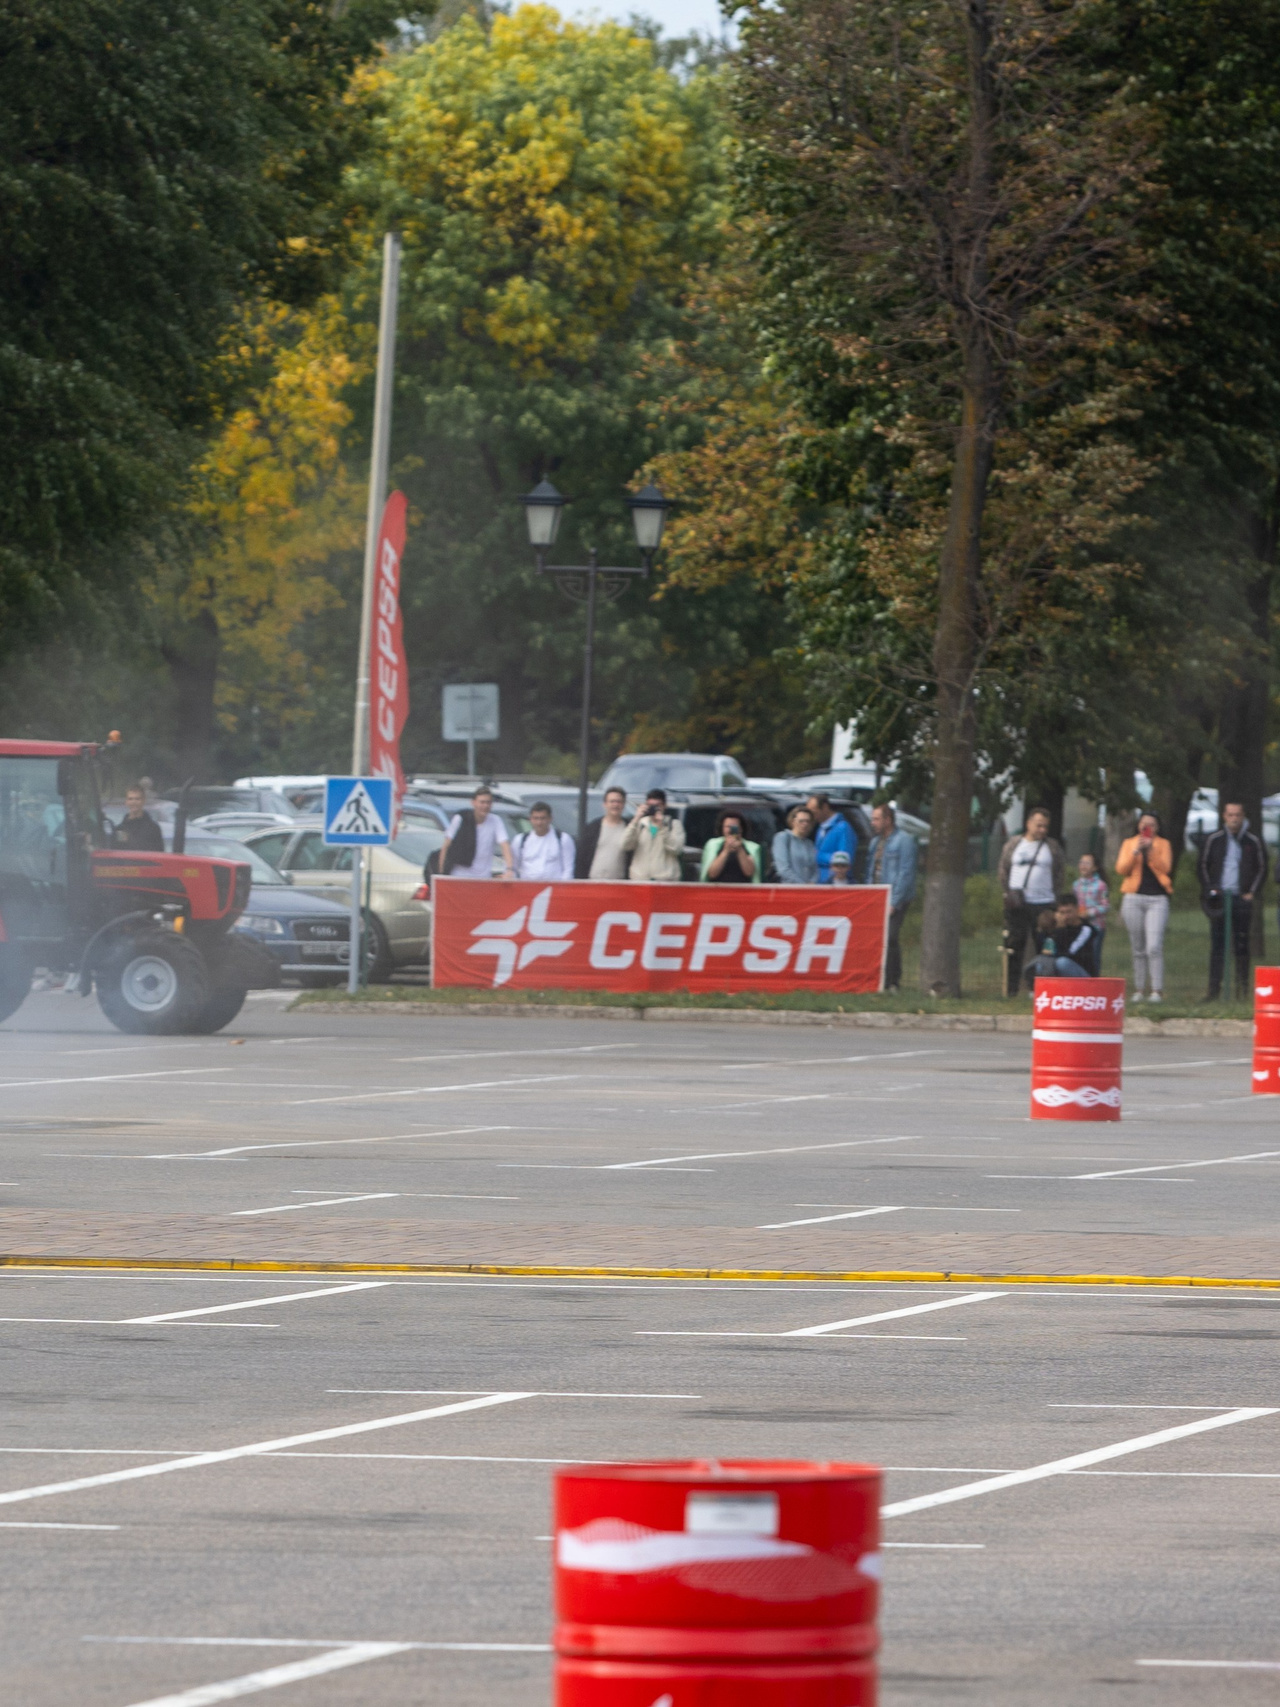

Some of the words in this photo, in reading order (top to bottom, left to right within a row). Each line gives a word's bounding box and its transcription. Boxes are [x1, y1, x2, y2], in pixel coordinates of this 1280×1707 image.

[376, 538, 400, 742] CEPSA
[588, 911, 853, 974] CEPSA
[1050, 996, 1107, 1010] CEPSA
